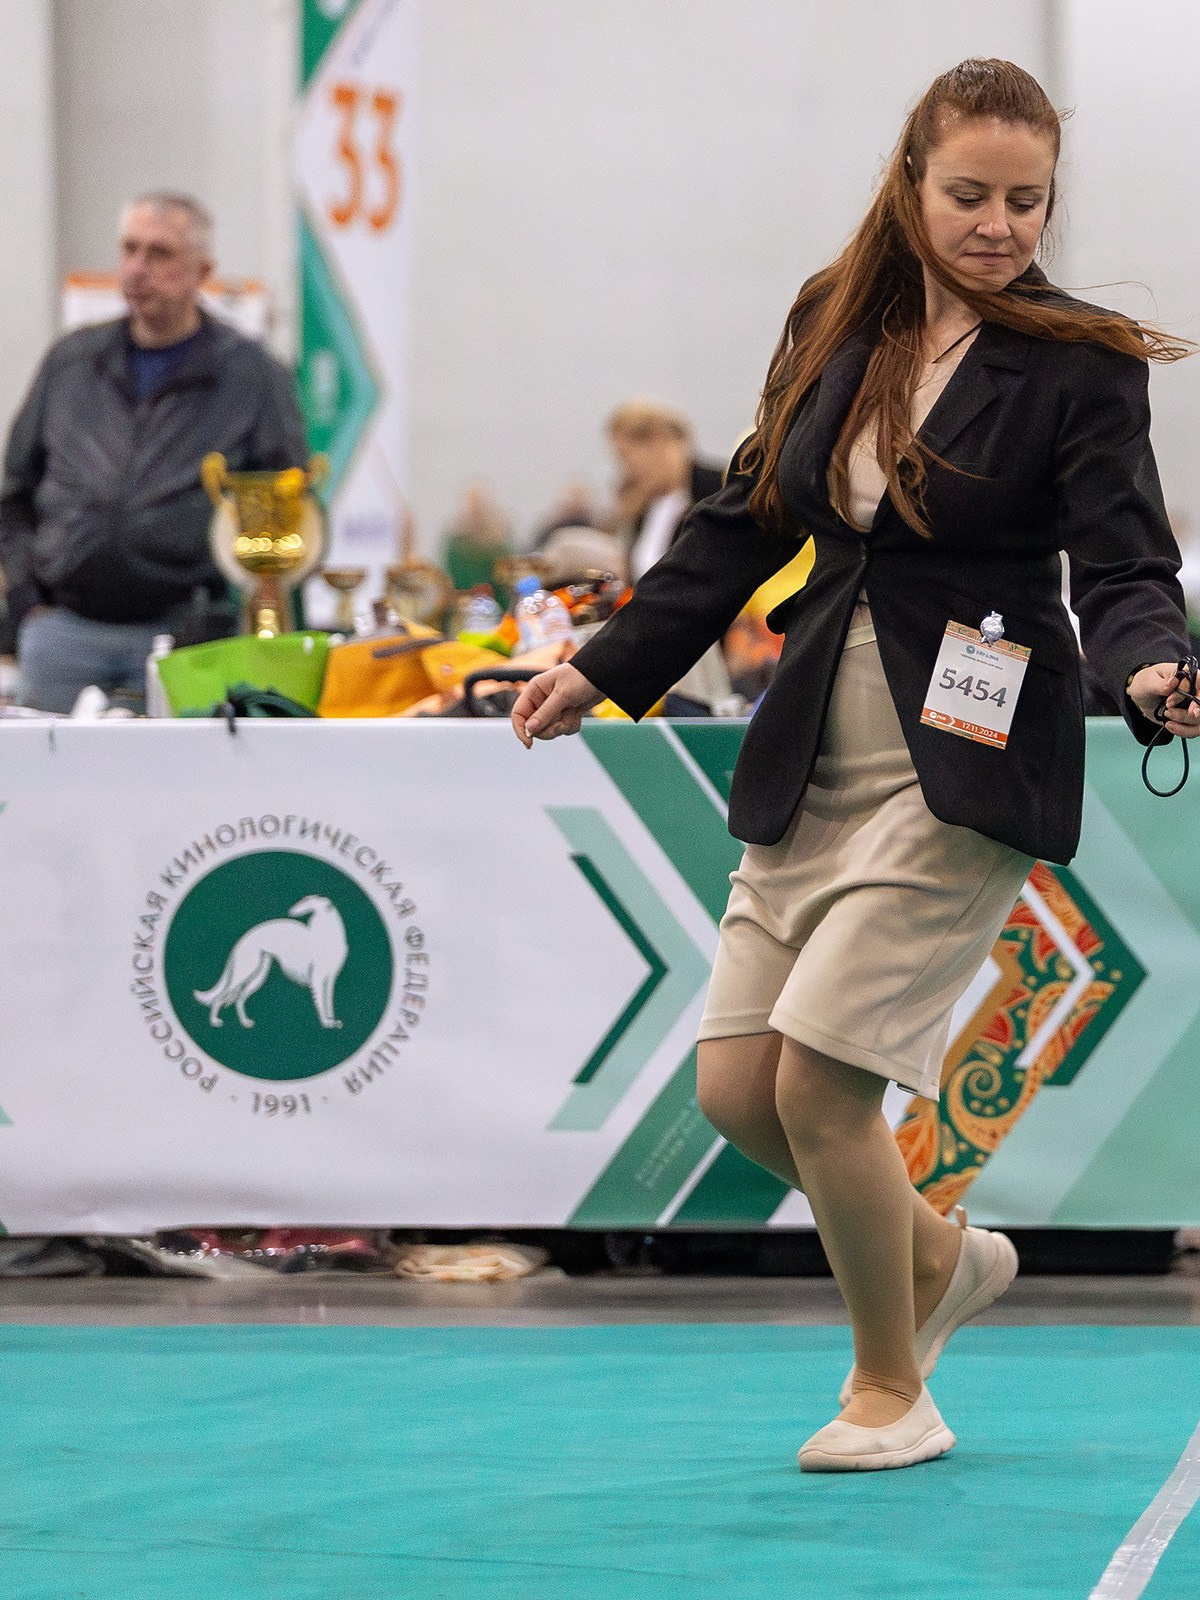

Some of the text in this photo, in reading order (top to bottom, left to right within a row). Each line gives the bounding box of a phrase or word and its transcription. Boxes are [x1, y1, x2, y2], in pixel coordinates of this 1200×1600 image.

[330, 82, 403, 234] 33
[939, 667, 1007, 708] 5454
[129, 813, 431, 1096] РОССИЙСКАЯ КИНОЛОГИЧЕСКАЯ ФЕДЕРАЦИЯ
[251, 1091, 313, 1116] 1991
